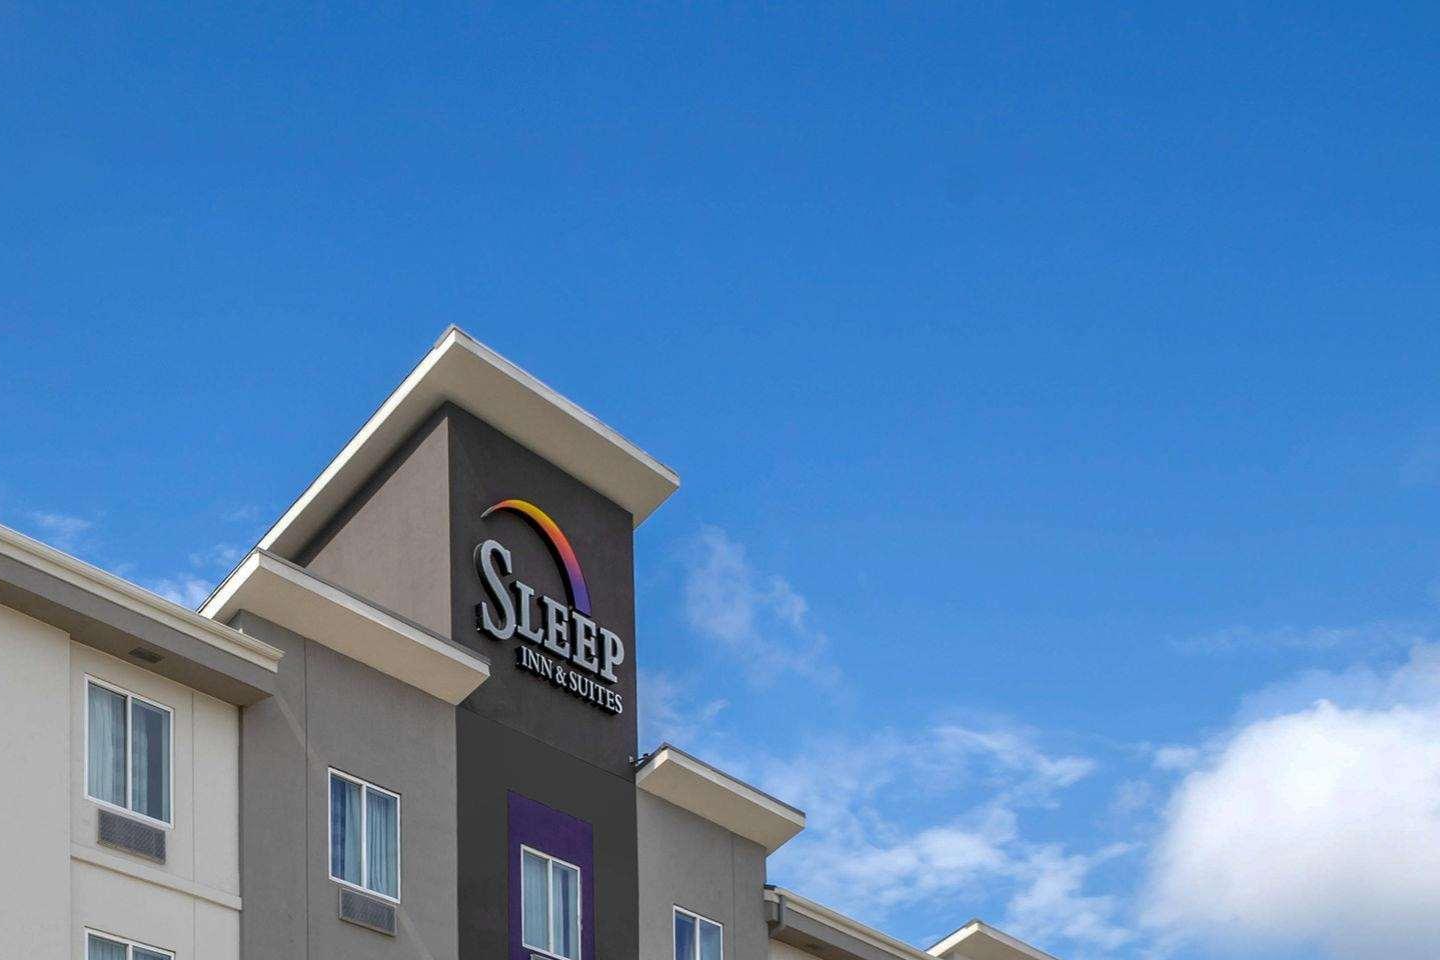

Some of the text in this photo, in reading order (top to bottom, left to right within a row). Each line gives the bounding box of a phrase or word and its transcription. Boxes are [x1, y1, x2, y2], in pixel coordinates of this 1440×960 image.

[521, 645, 624, 714] INN & SUITES
